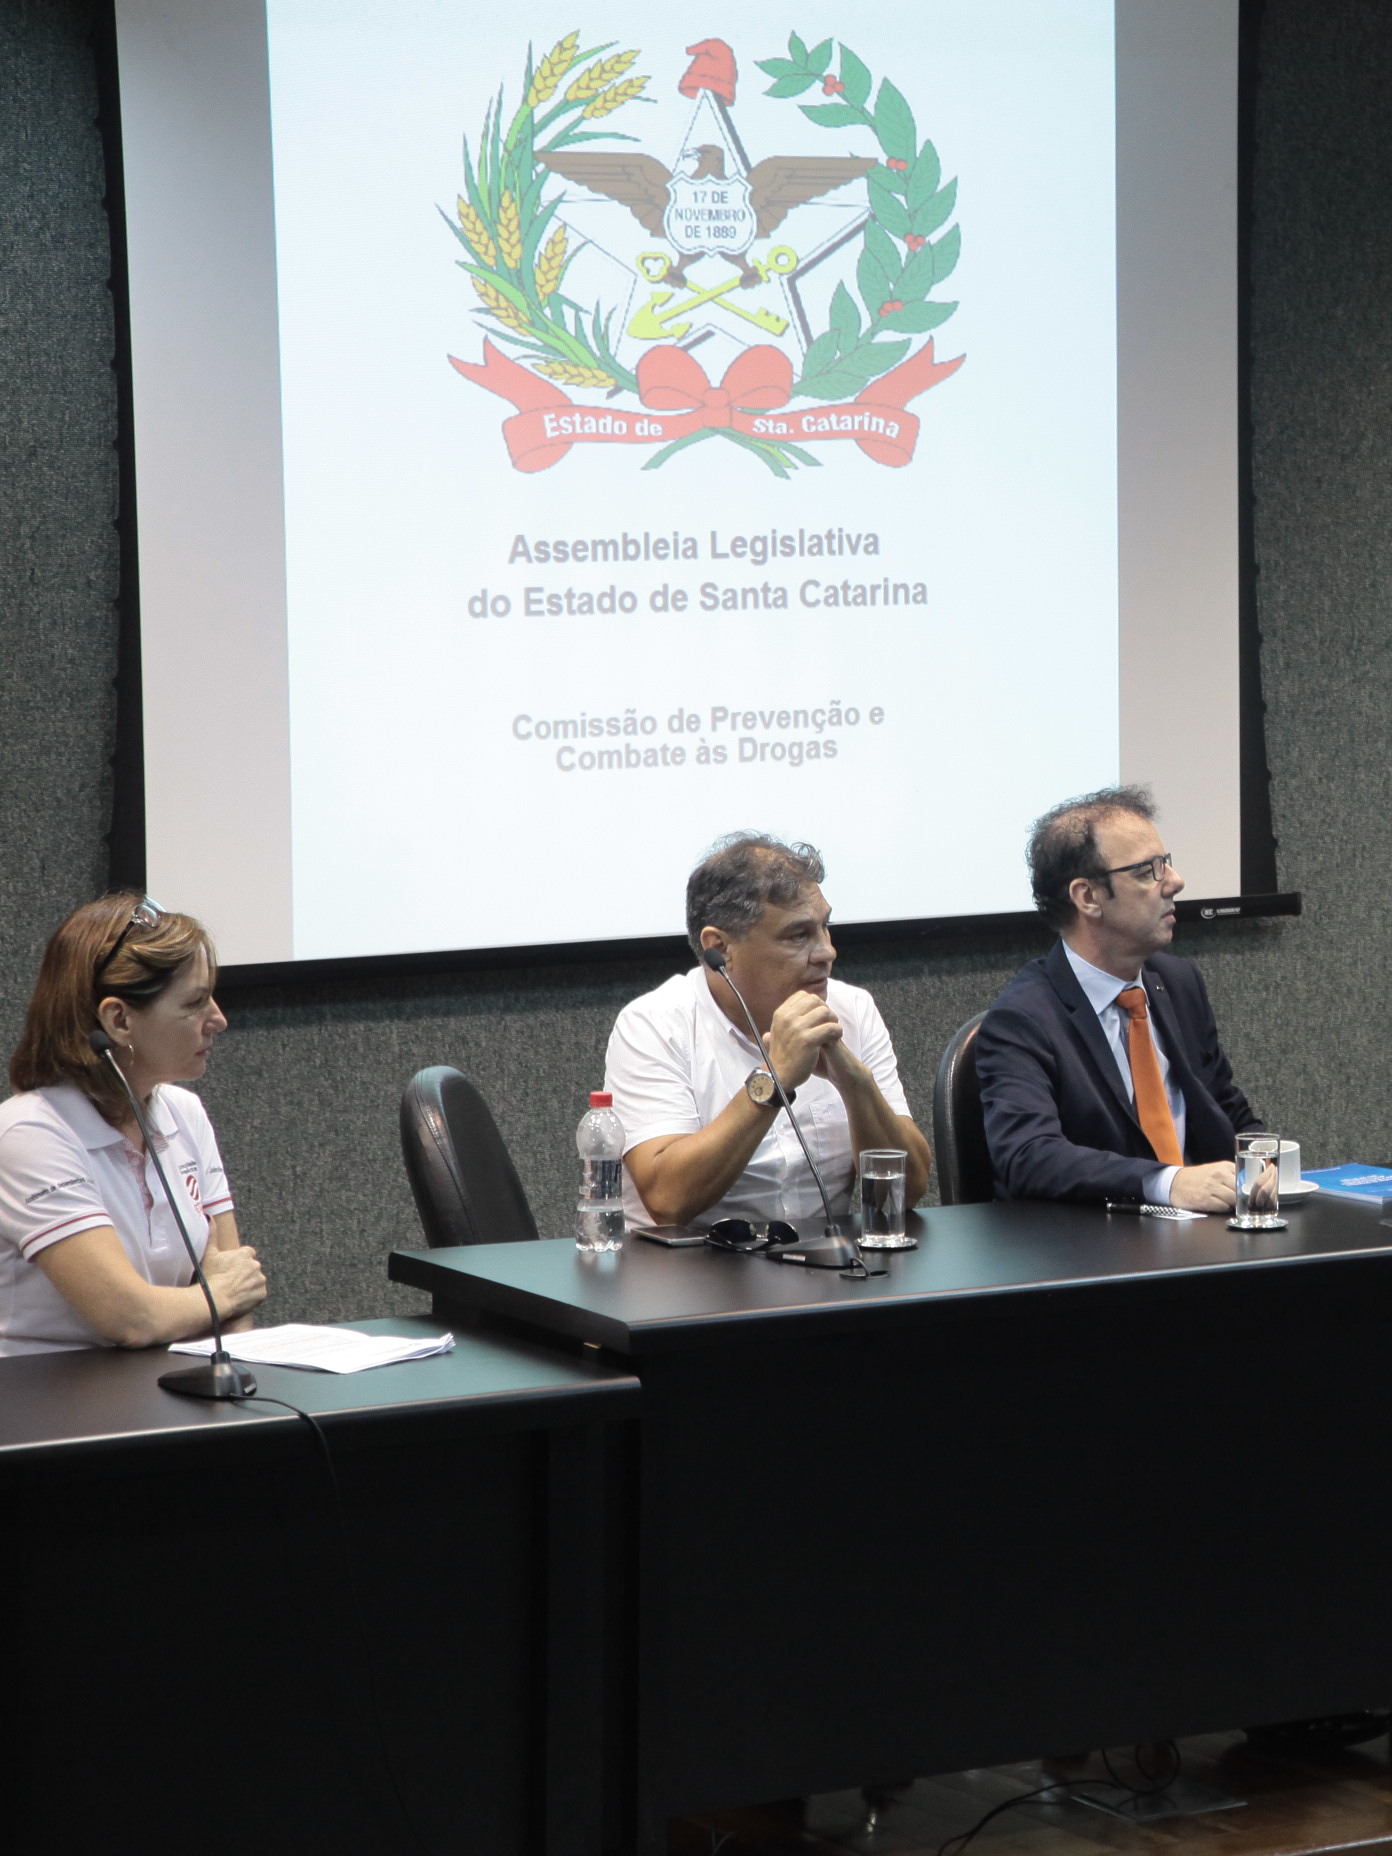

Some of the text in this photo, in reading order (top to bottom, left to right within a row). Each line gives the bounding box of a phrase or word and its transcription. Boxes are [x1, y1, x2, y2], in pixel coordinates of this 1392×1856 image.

[693, 191, 729, 204] 17 DE
[675, 208, 746, 221] NOVEMBRO
[685, 225, 737, 239] DE 1889
[543, 411, 900, 439] Estado de Sta. Catarina
[508, 527, 880, 566] Assembleia Legislativa
[467, 577, 928, 619] do Estado de Santa Catarina
[512, 700, 885, 741] Comissão de Prevenção e
[556, 735, 838, 772] Combate às Drogas
